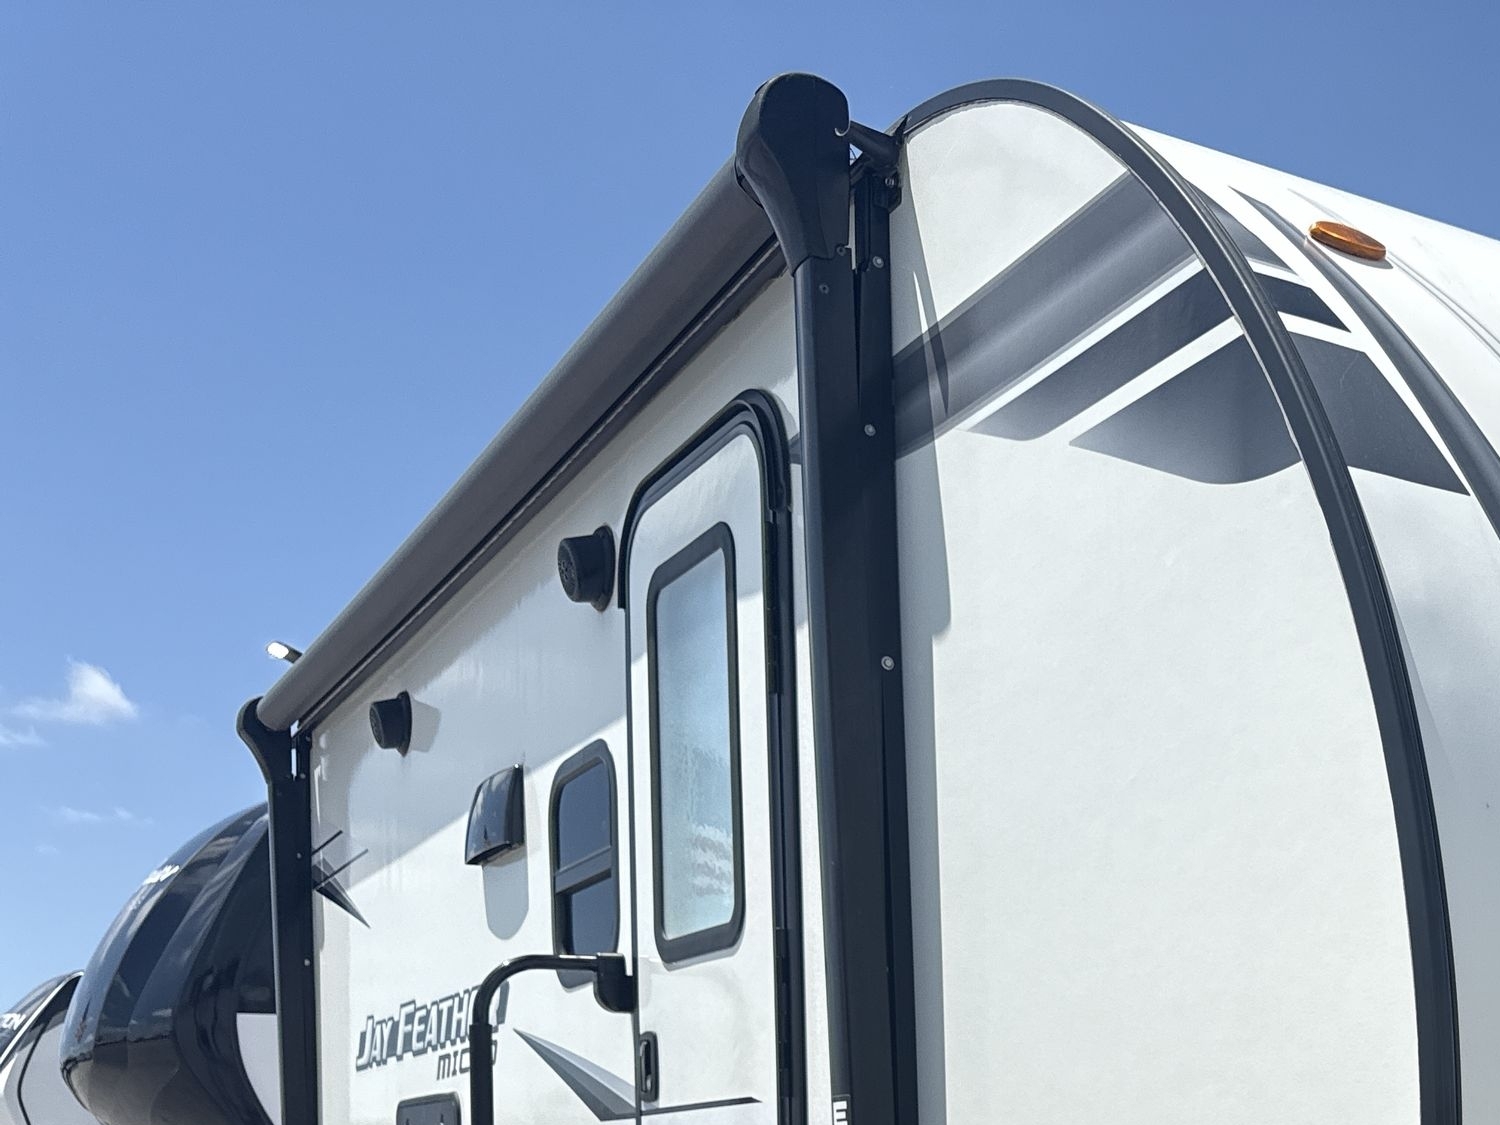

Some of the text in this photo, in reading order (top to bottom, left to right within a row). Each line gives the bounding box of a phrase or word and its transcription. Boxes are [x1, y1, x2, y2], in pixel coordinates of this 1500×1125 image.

[356, 978, 510, 1071] JAY FEATH
[436, 1039, 498, 1081] MIC
